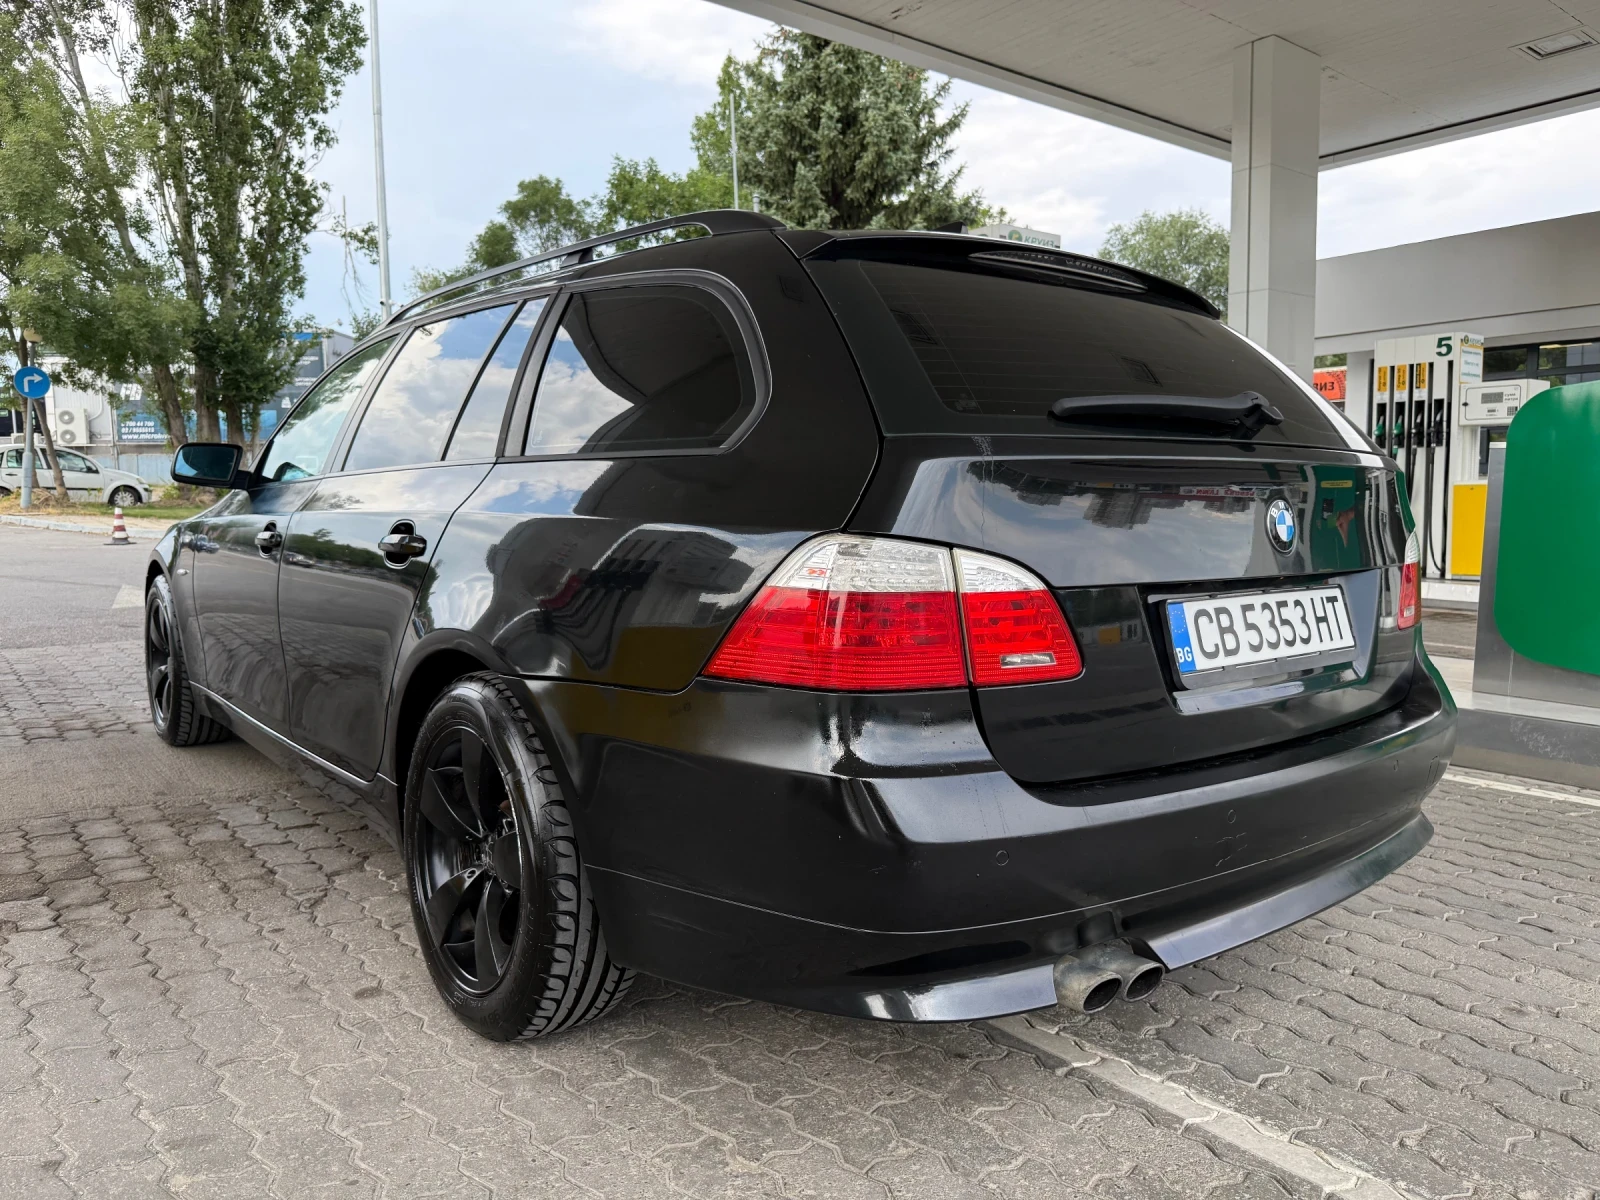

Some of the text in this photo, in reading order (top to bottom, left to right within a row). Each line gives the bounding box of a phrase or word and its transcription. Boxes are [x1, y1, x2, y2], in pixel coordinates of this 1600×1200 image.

[1024, 236, 1055, 247] КРУИЗ
[1436, 336, 1453, 357] 5
[1271, 501, 1293, 518] BMW
[1193, 595, 1344, 660] CB 5353 HT
[1176, 647, 1193, 663] BG
